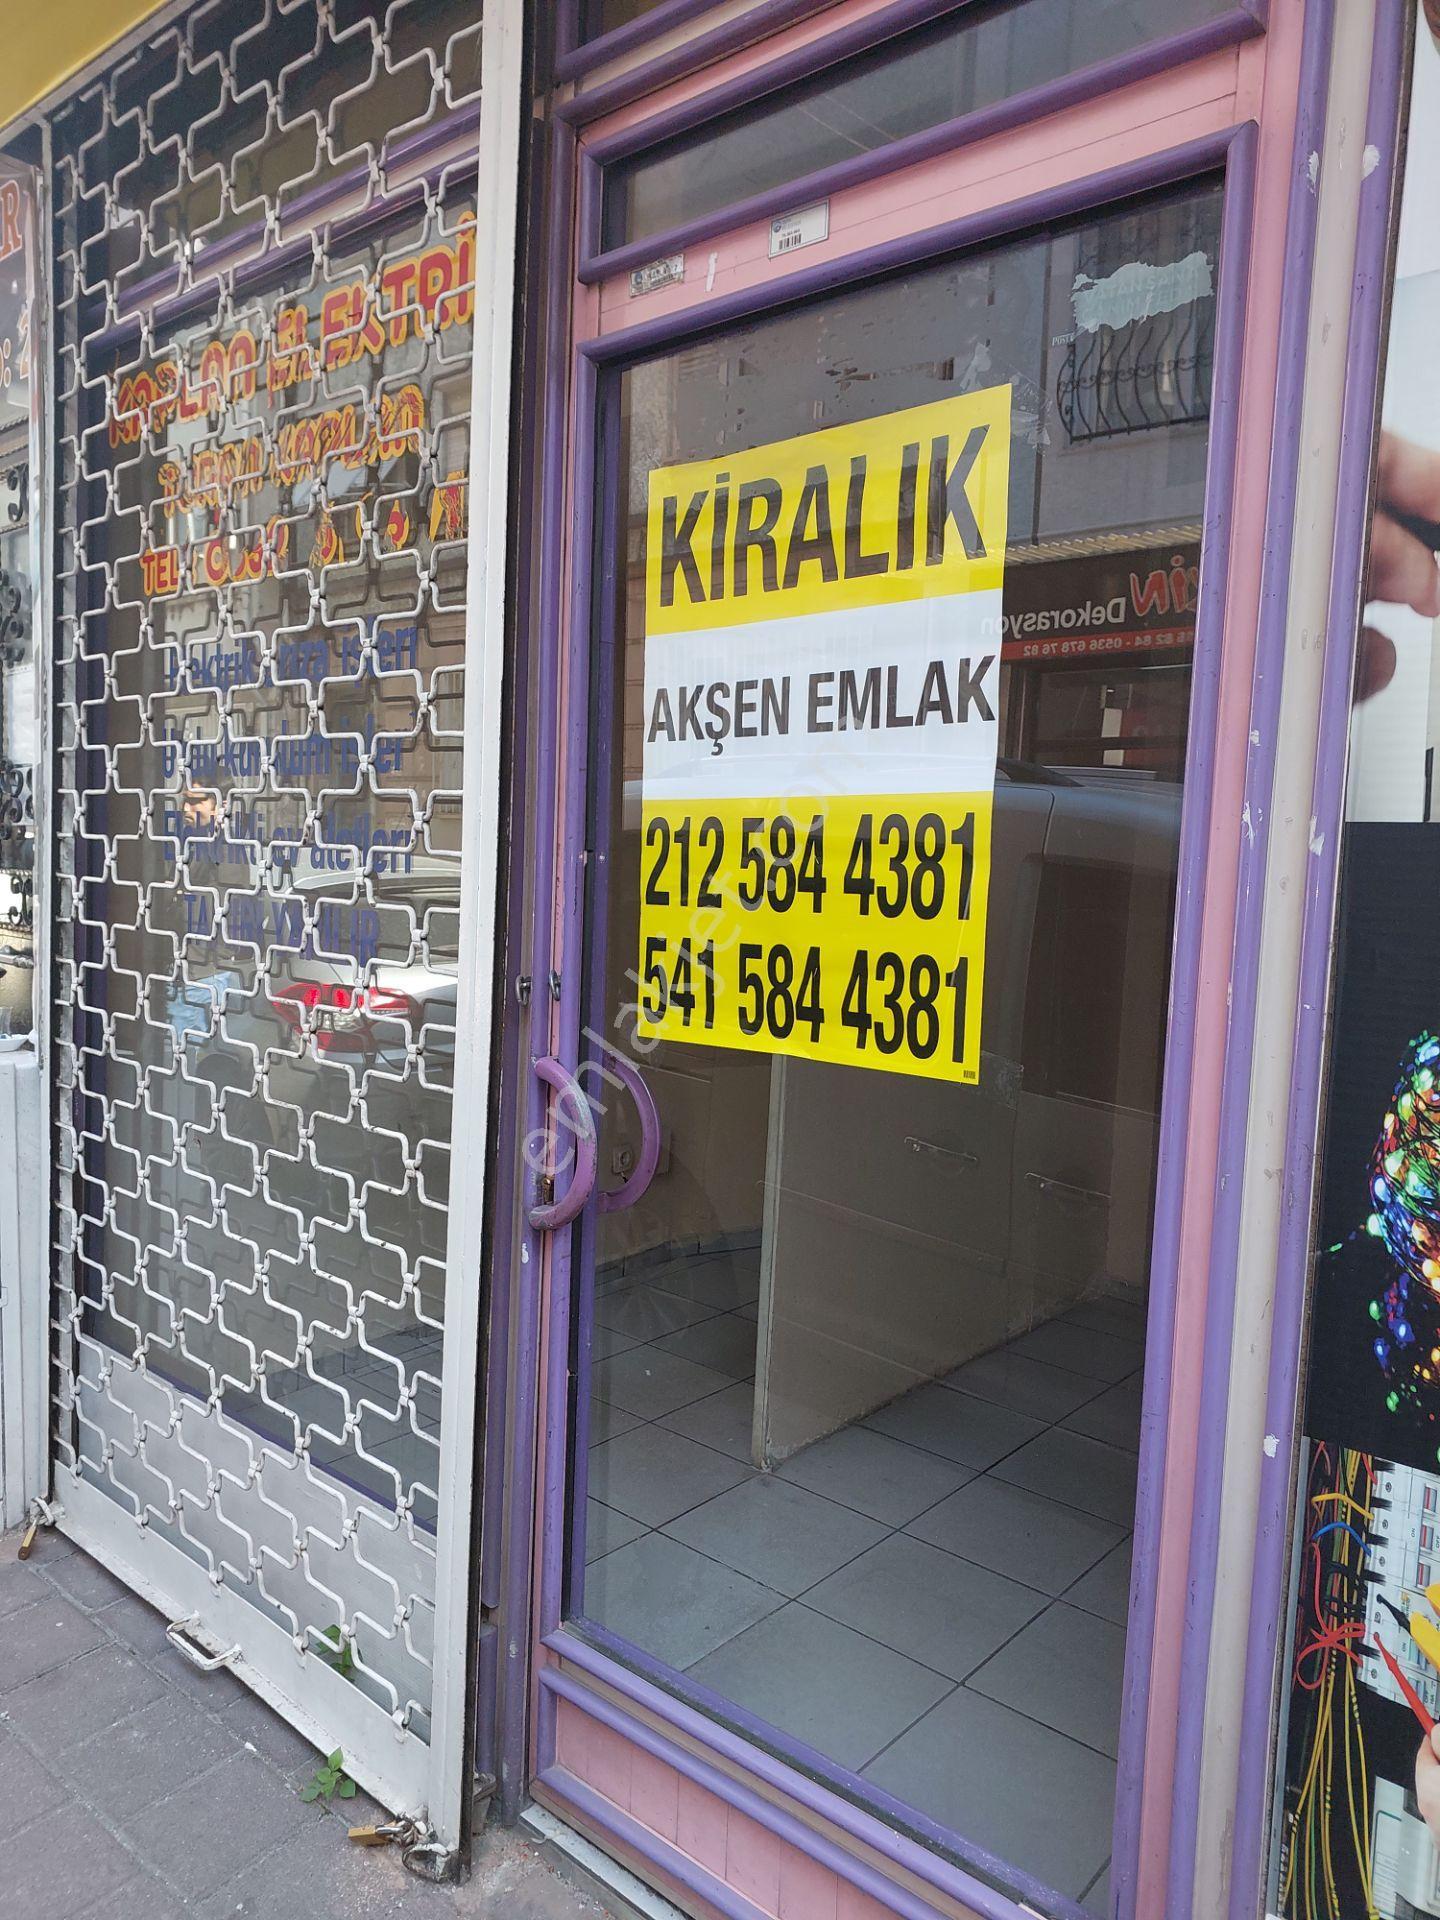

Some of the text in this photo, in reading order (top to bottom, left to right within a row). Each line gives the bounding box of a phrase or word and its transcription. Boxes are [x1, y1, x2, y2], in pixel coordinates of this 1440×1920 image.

[660, 424, 991, 608] KİRALIK
[646, 655, 996, 756] AKŞEN EMLAK
[645, 812, 975, 921] 212 584 4381
[643, 936, 969, 1064] 541 584 4381
